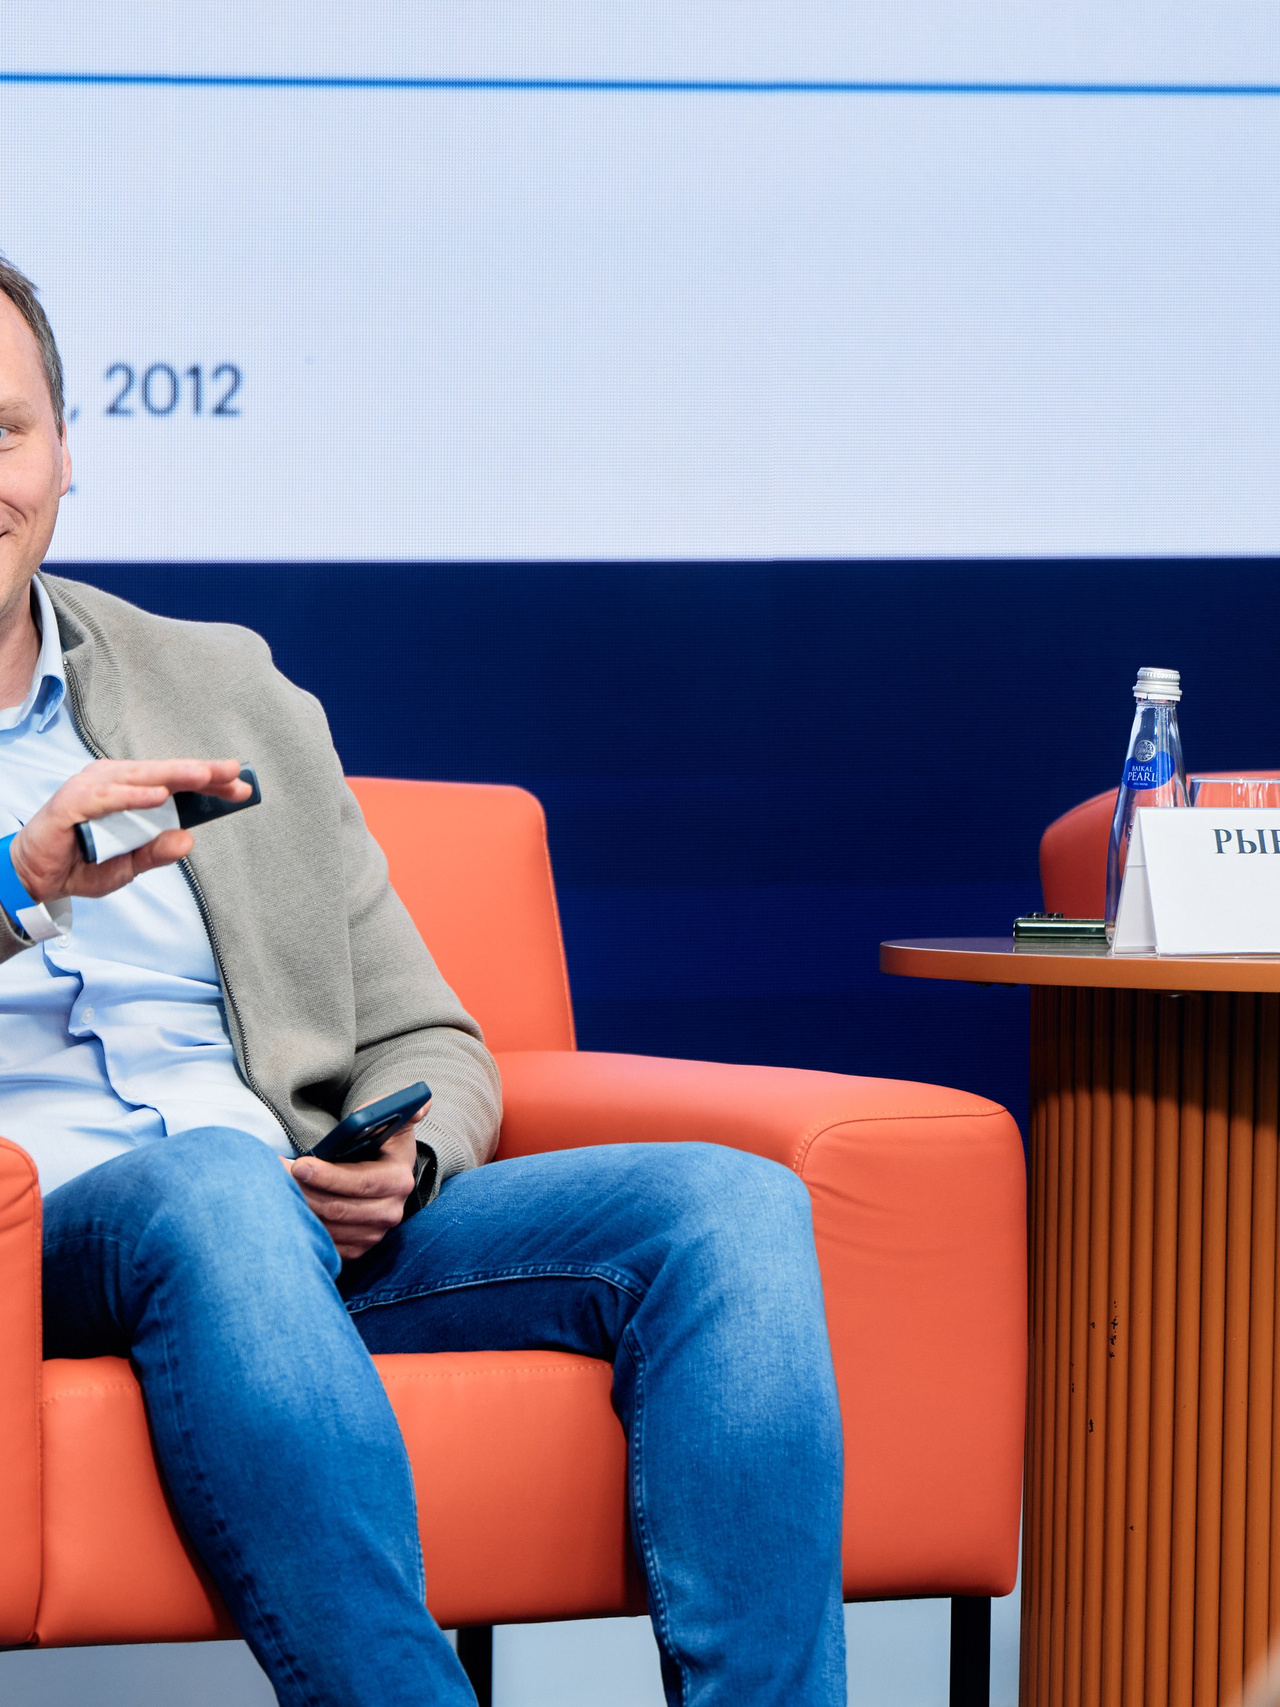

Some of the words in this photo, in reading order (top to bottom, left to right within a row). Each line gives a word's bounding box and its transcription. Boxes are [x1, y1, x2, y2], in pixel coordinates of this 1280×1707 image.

[105, 362, 243, 418] 2012
[1132, 765, 1153, 773] BAIKAL
[1127, 771, 1158, 783] PEARL
